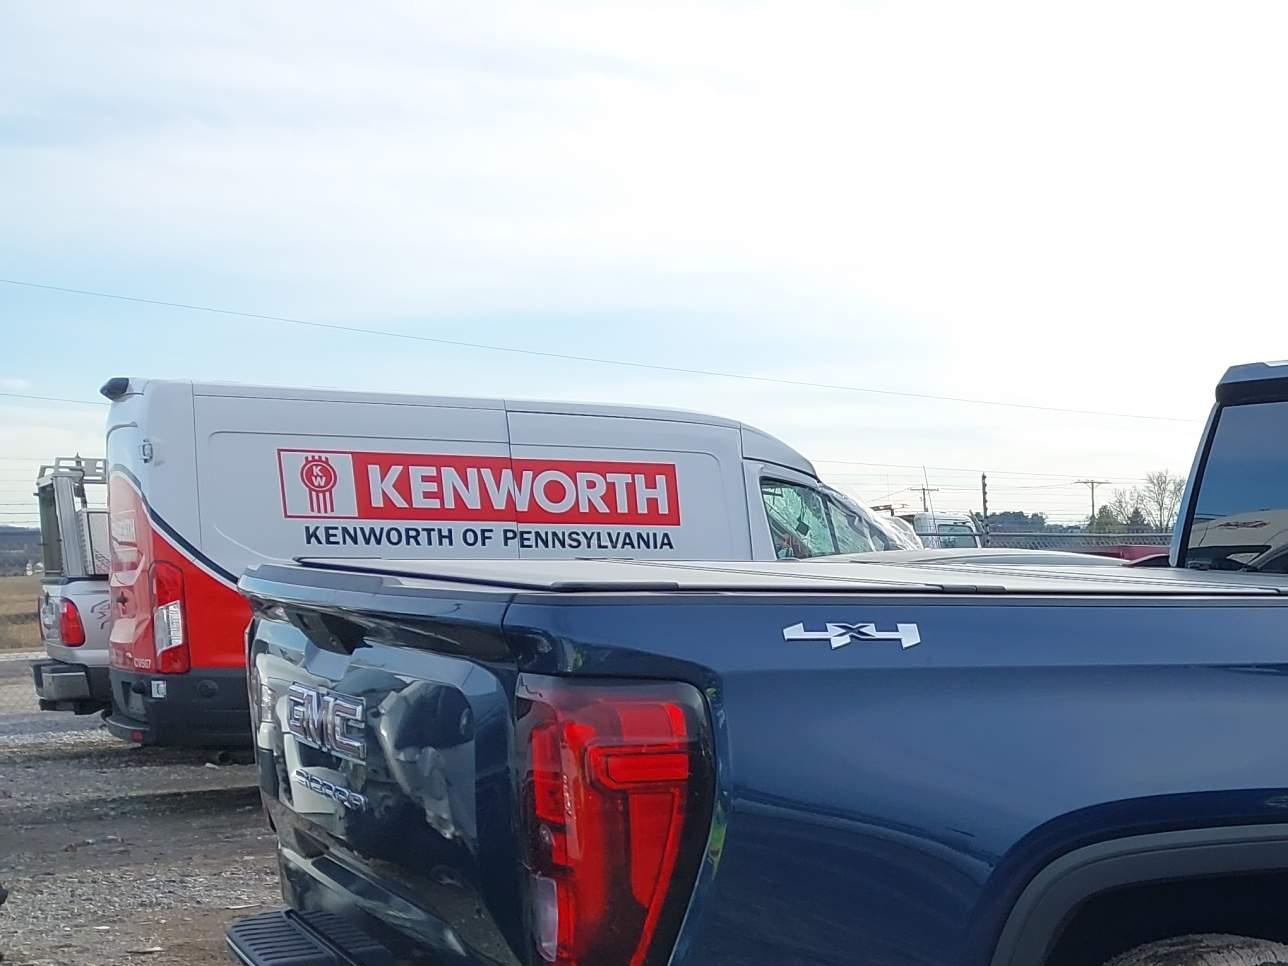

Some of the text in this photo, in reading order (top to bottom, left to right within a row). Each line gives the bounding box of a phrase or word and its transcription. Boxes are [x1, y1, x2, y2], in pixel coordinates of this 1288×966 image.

[367, 463, 670, 515] KENWORTH
[304, 525, 675, 550] KENWORTH OF PENNSYLVANIA
[288, 682, 367, 765] GMC
